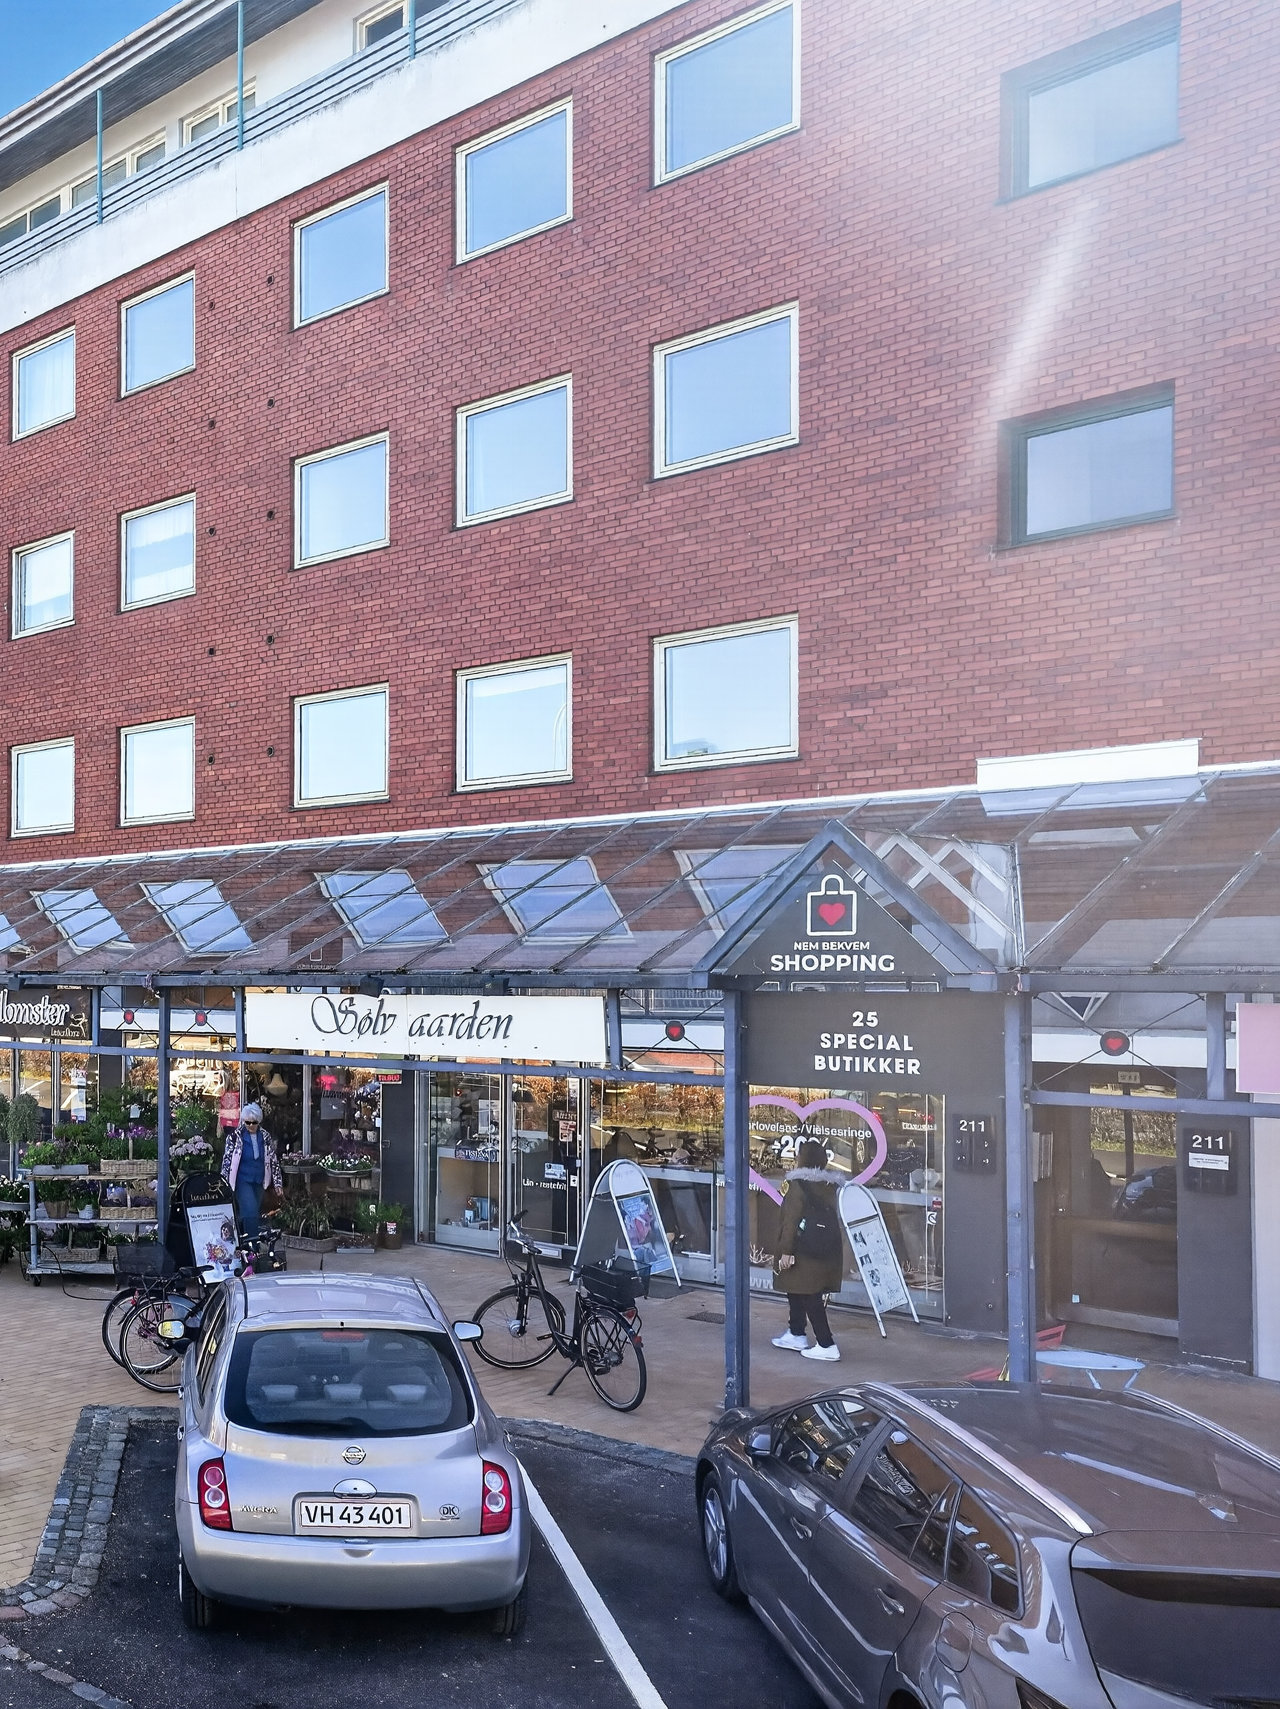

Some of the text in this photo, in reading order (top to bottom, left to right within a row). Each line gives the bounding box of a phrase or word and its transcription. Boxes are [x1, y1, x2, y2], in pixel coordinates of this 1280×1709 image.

[793, 941, 870, 951] NEM BEKVEM
[770, 954, 896, 973] SHOPPING
[311, 995, 397, 1039] Sølv
[851, 1011, 879, 1027] 25
[820, 1033, 914, 1051] SPECIAL
[814, 1055, 921, 1075] BUTIKKER
[959, 1119, 985, 1132] 211
[1192, 1135, 1223, 1150] 211
[304, 1505, 402, 1525] VH 43 401
[442, 1506, 458, 1516] DK
